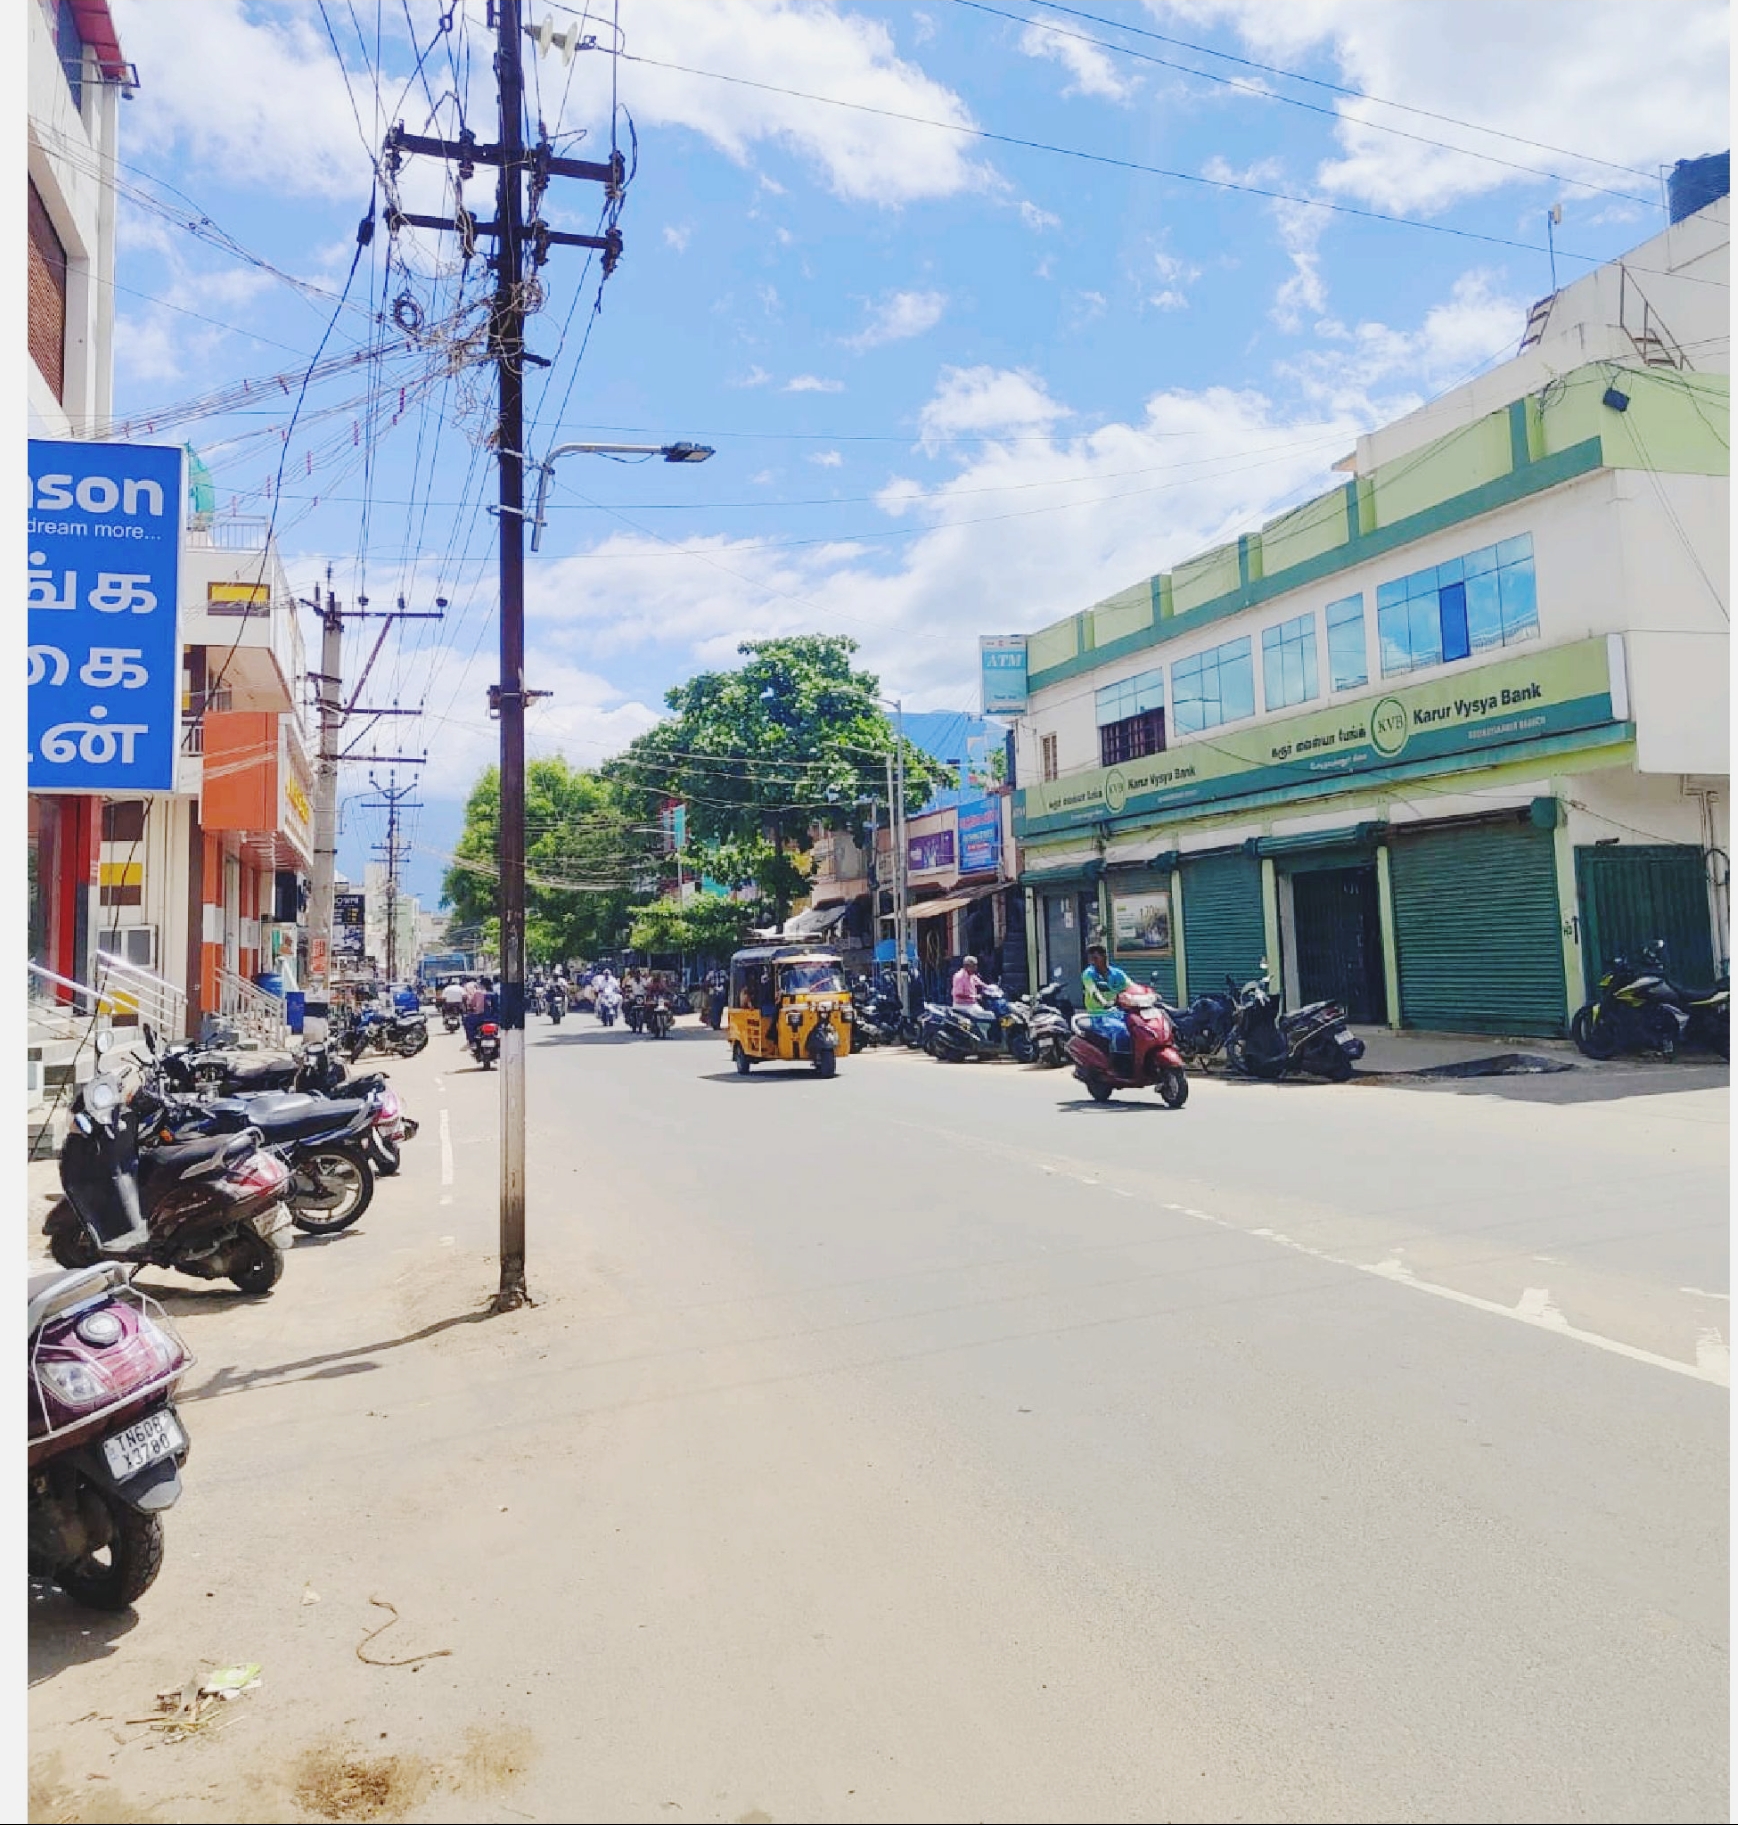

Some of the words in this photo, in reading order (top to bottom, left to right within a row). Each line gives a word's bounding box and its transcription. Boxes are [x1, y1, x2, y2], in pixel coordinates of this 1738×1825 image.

[94, 524, 162, 541] more...
[986, 653, 1023, 667] ATM
[1413, 706, 1451, 725] Karur
[1454, 696, 1498, 718] Vysya
[1501, 682, 1542, 706] Bank
[1377, 715, 1403, 733] KVB
[28, 705, 149, 764] ன்
[1174, 765, 1196, 780] Bank
